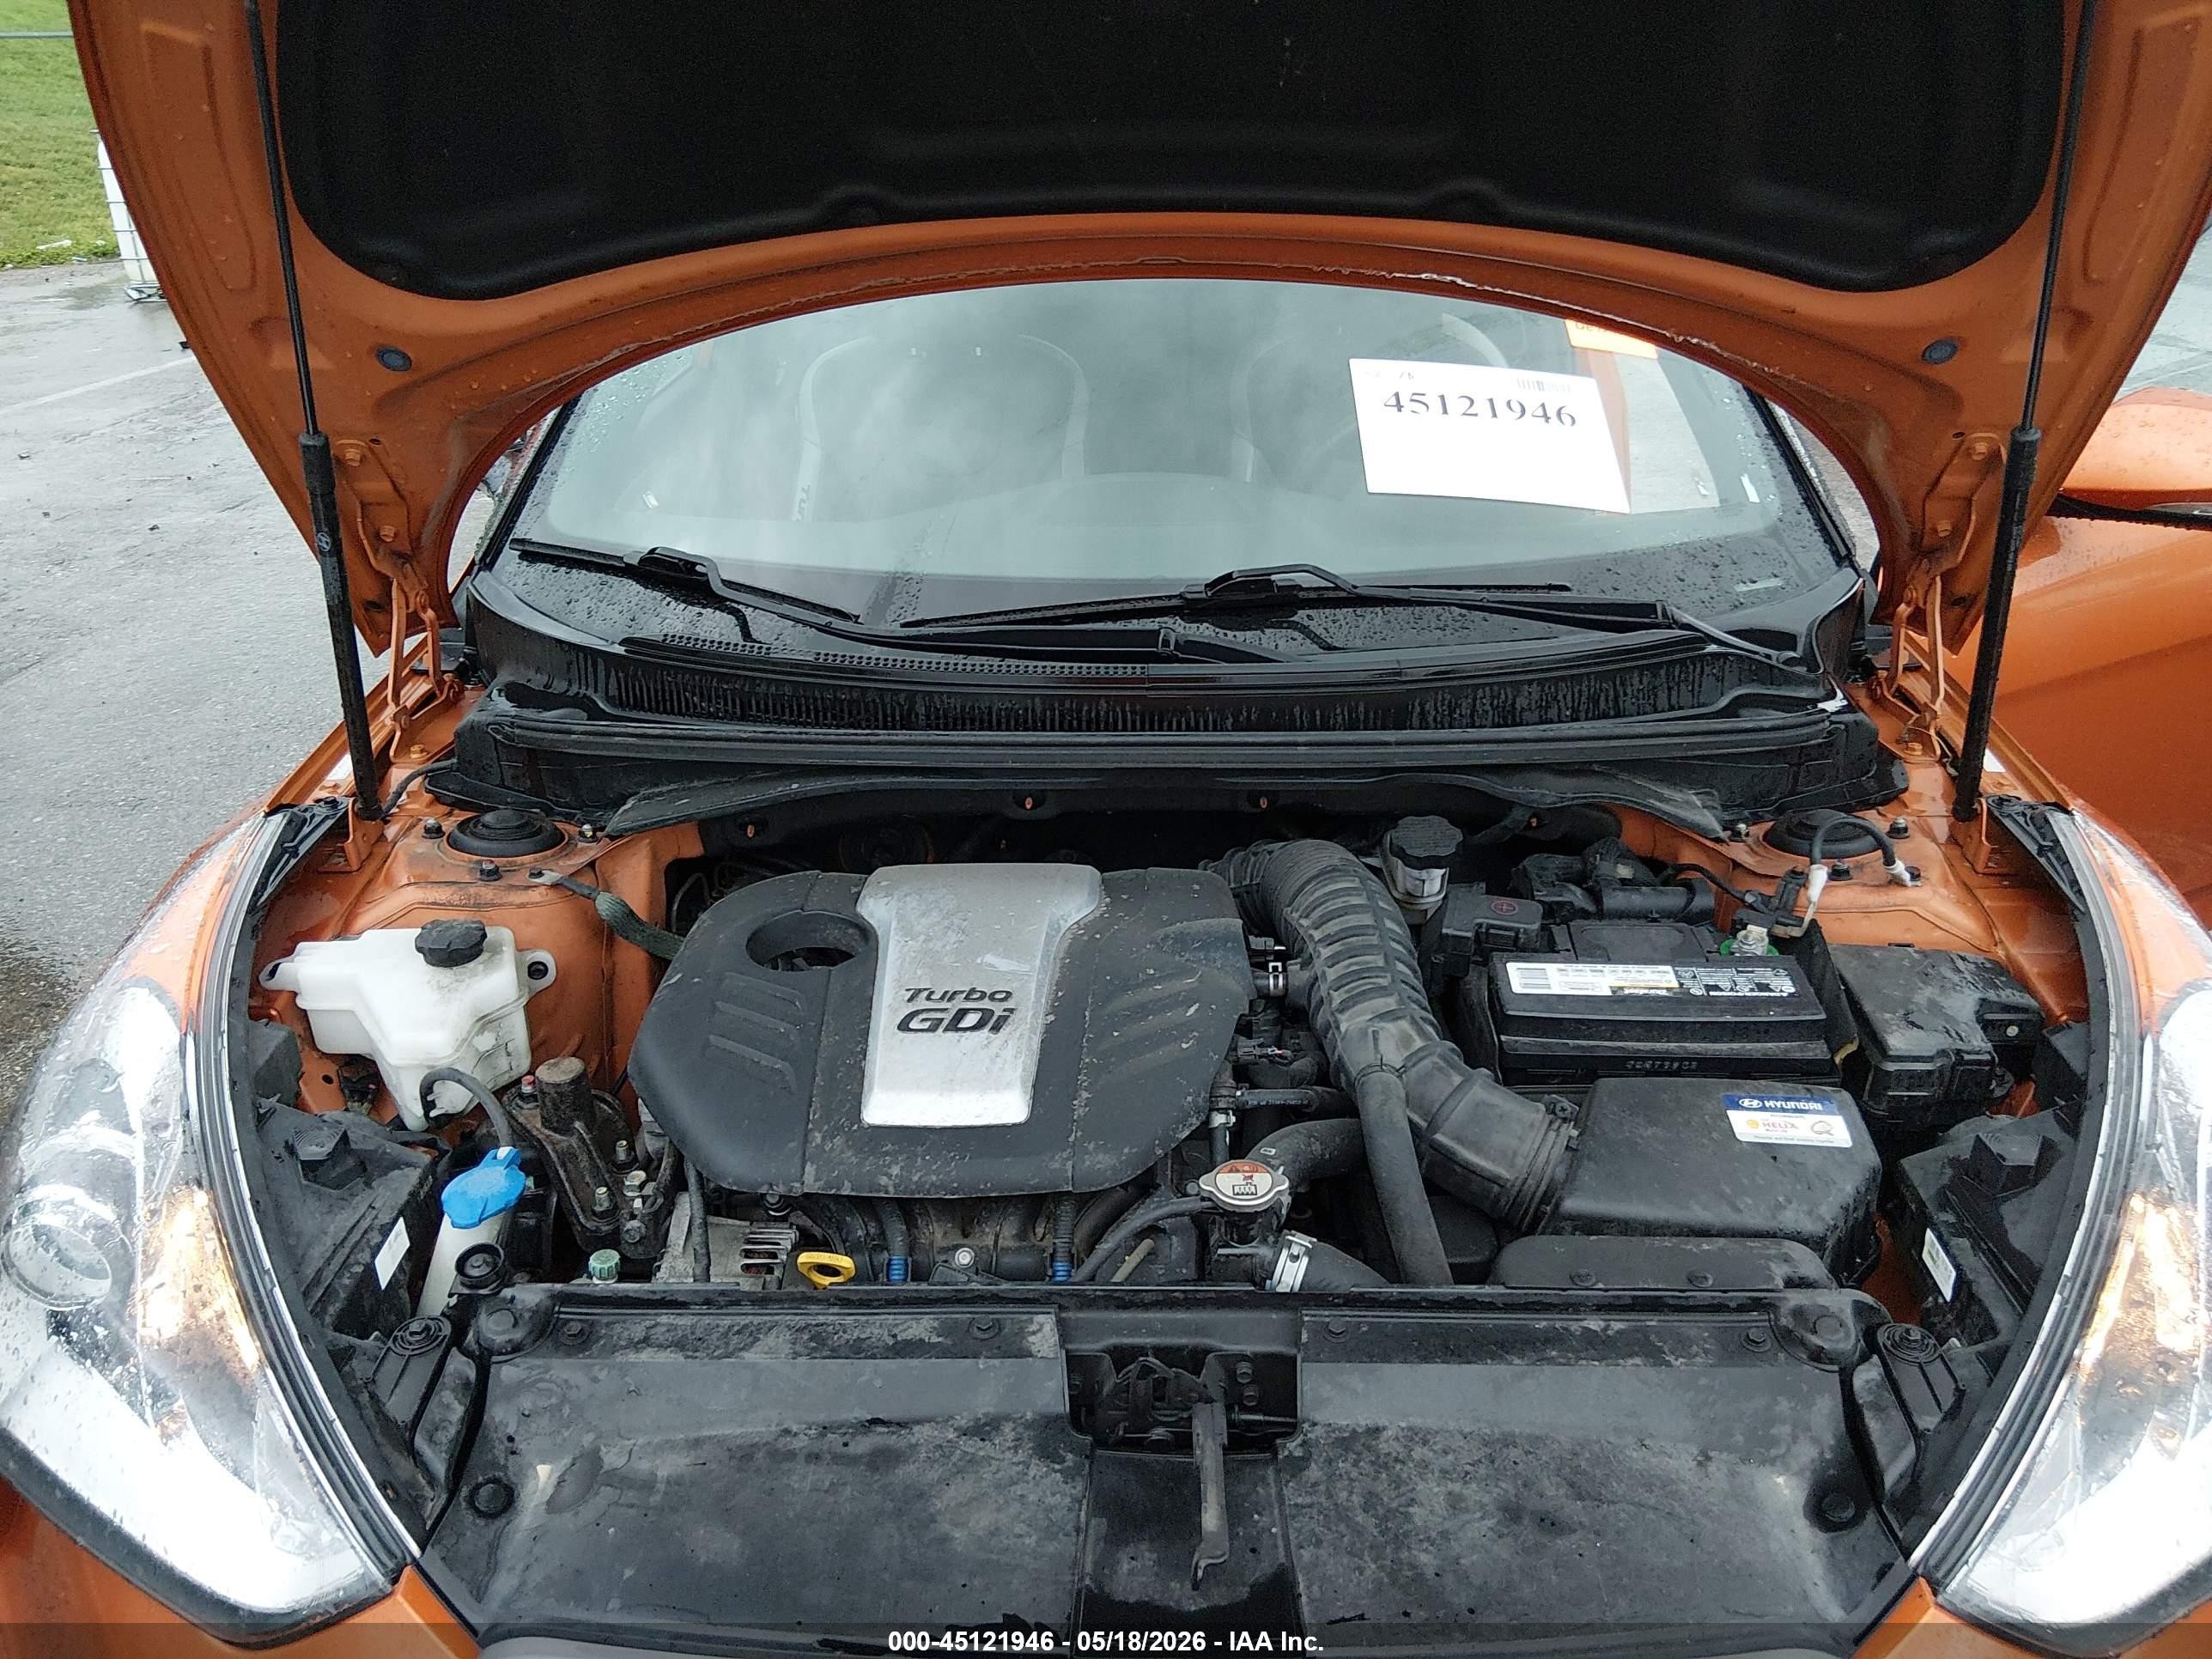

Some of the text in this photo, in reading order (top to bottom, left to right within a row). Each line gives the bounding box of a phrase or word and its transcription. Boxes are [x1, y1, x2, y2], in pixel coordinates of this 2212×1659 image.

[1383, 392, 1577, 427] 45121946
[905, 988, 1012, 1003] Turbo
[897, 1007, 1017, 1035] GDi
[1764, 1100, 1823, 1110] HYUNDAI
